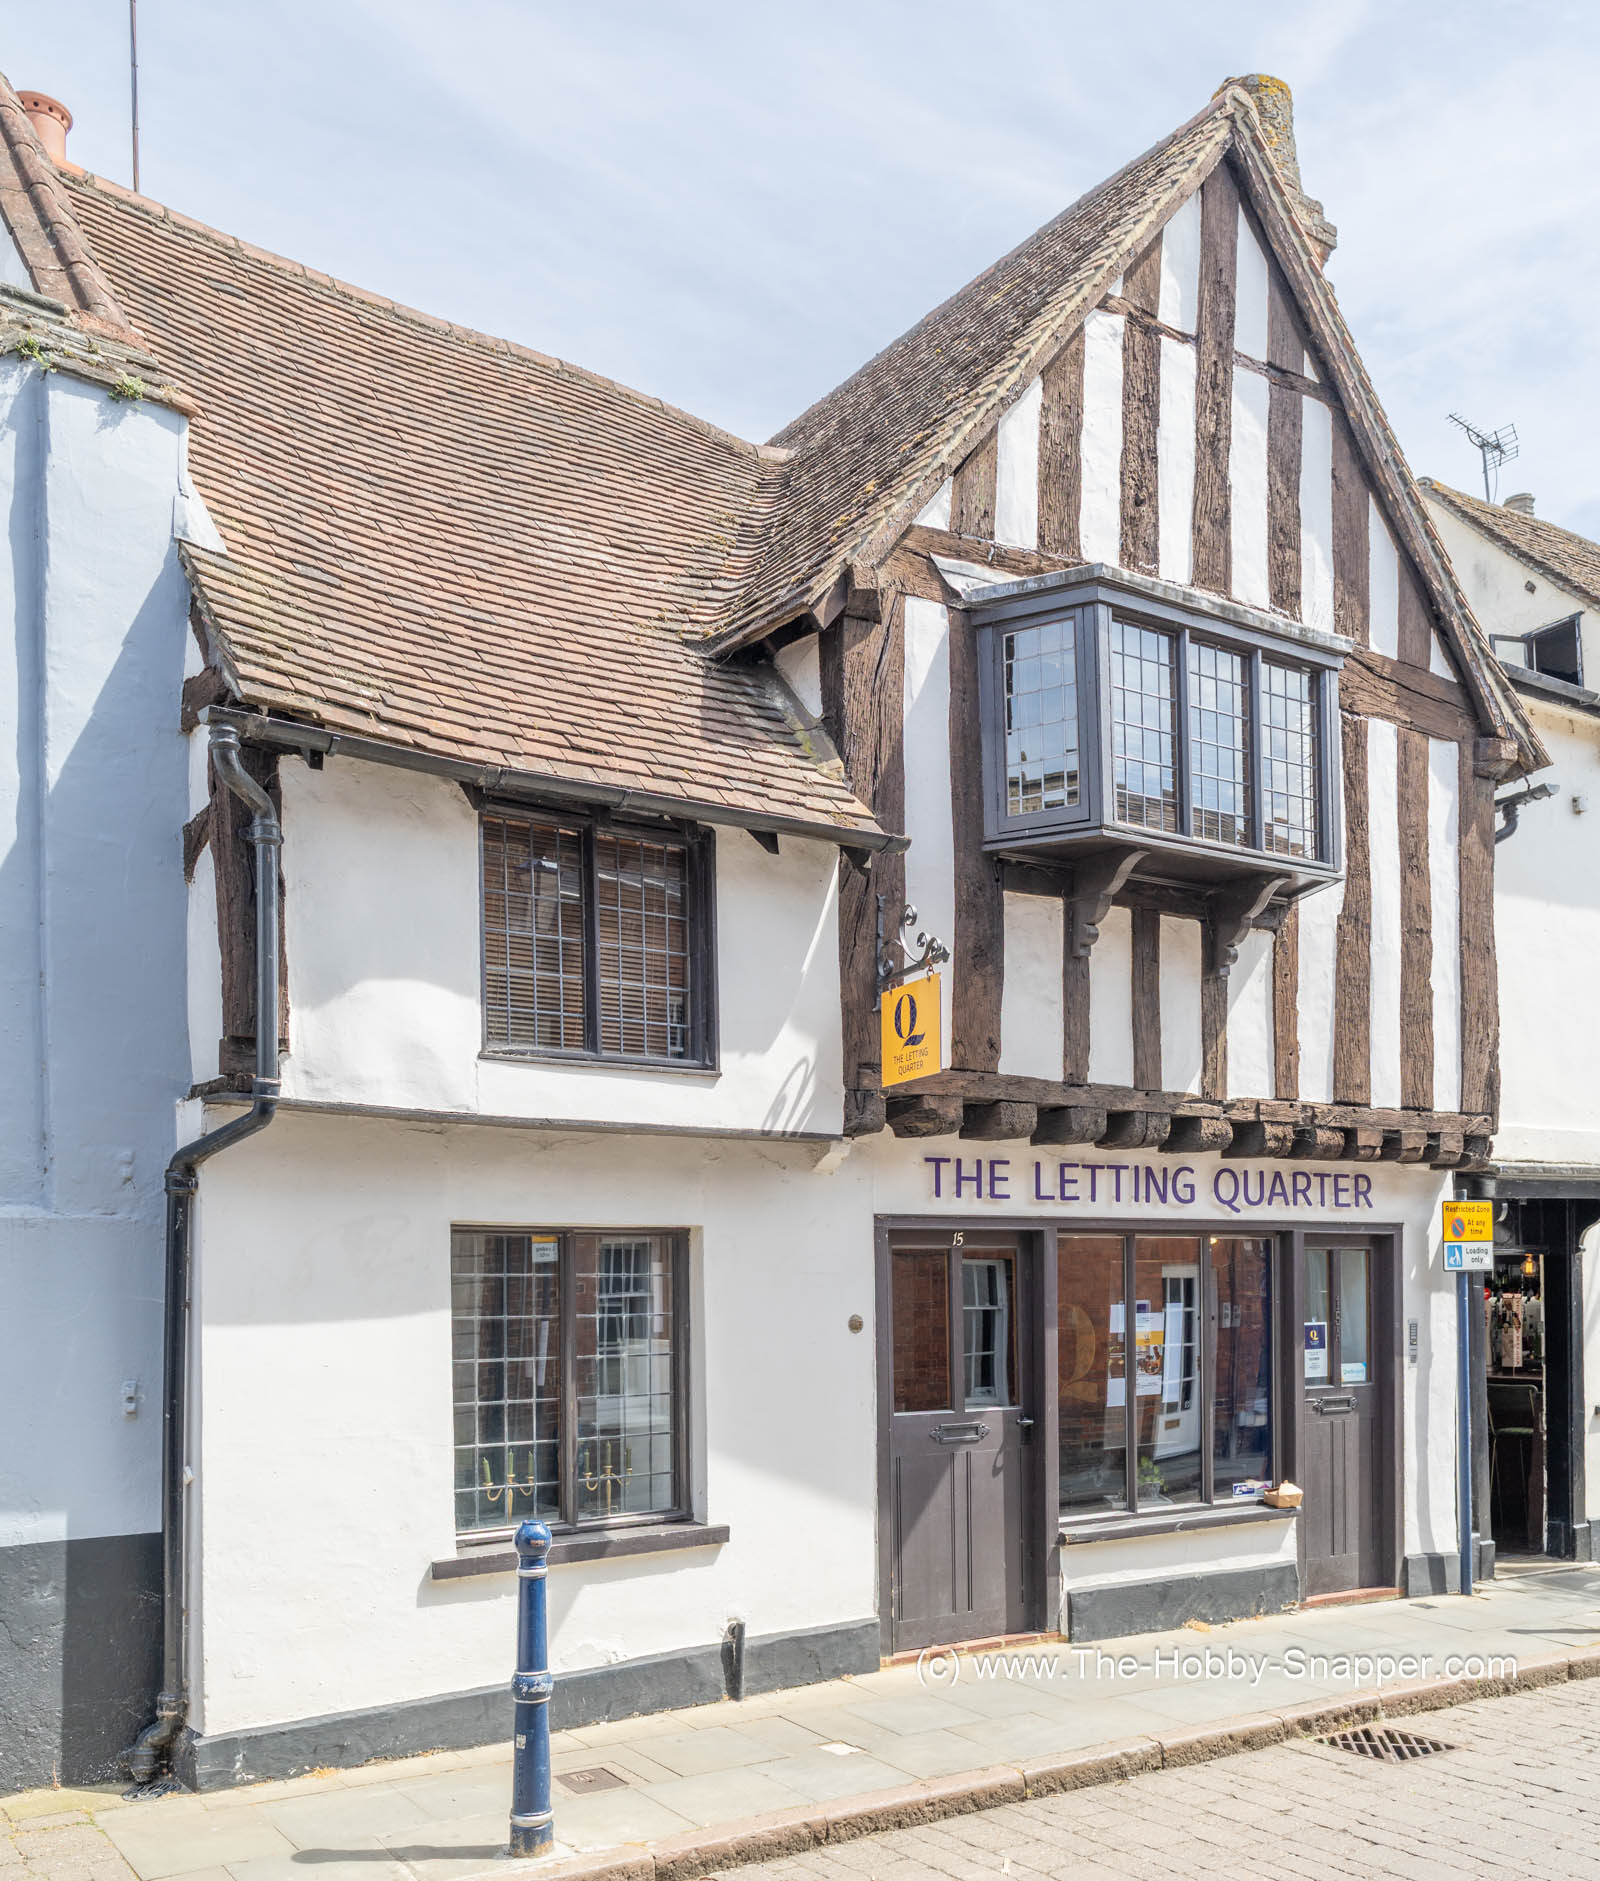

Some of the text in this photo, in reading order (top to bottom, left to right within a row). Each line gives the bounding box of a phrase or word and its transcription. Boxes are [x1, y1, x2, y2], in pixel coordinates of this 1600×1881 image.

[894, 993, 926, 1049] Q
[893, 1047, 928, 1064] THE LETTING
[898, 1060, 923, 1076] QUARTER
[924, 1157, 1374, 1213] THE LETTING QUARTER
[952, 1231, 964, 1246] 15
[1465, 1247, 1489, 1255] Loading
[1471, 1256, 1483, 1264] only
[1310, 1329, 1319, 1341] Q
